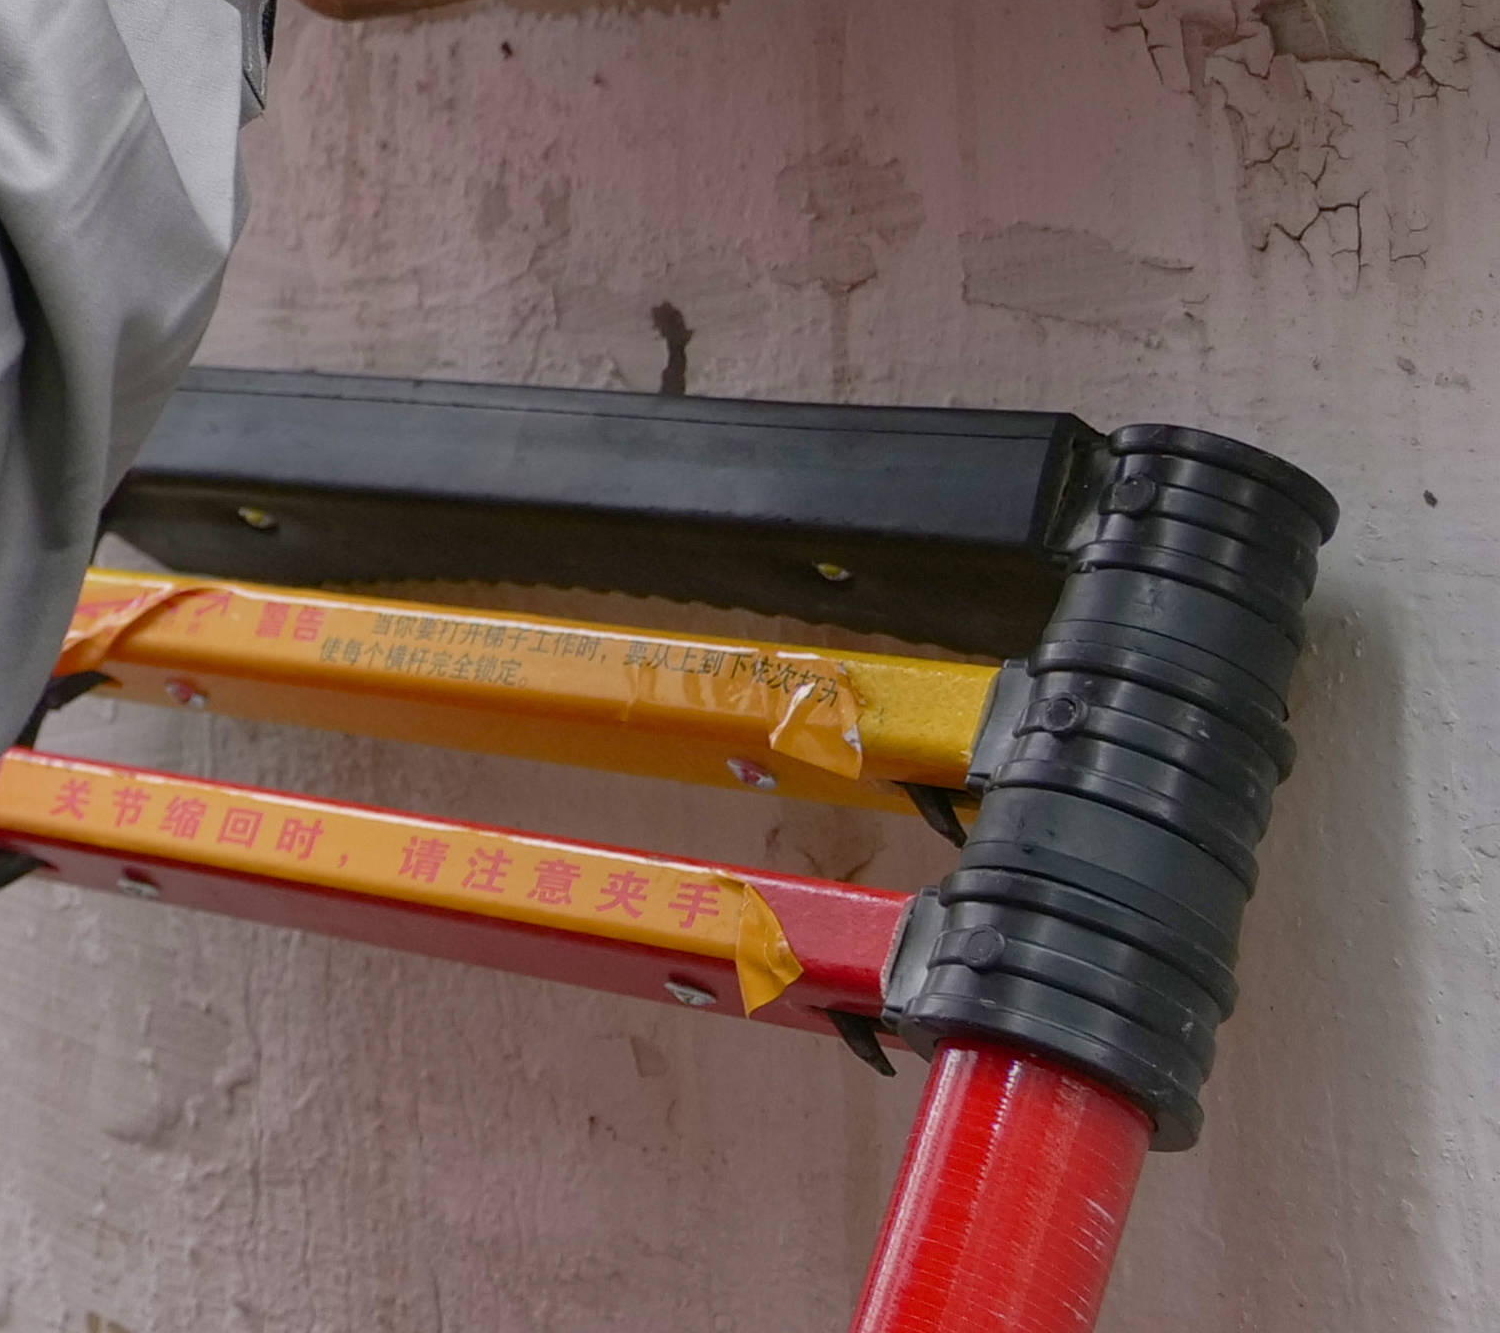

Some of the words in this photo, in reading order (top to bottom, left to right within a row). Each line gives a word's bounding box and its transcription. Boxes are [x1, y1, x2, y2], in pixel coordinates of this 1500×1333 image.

[50, 778, 721, 931] 关节缩回时，请注意夹手
